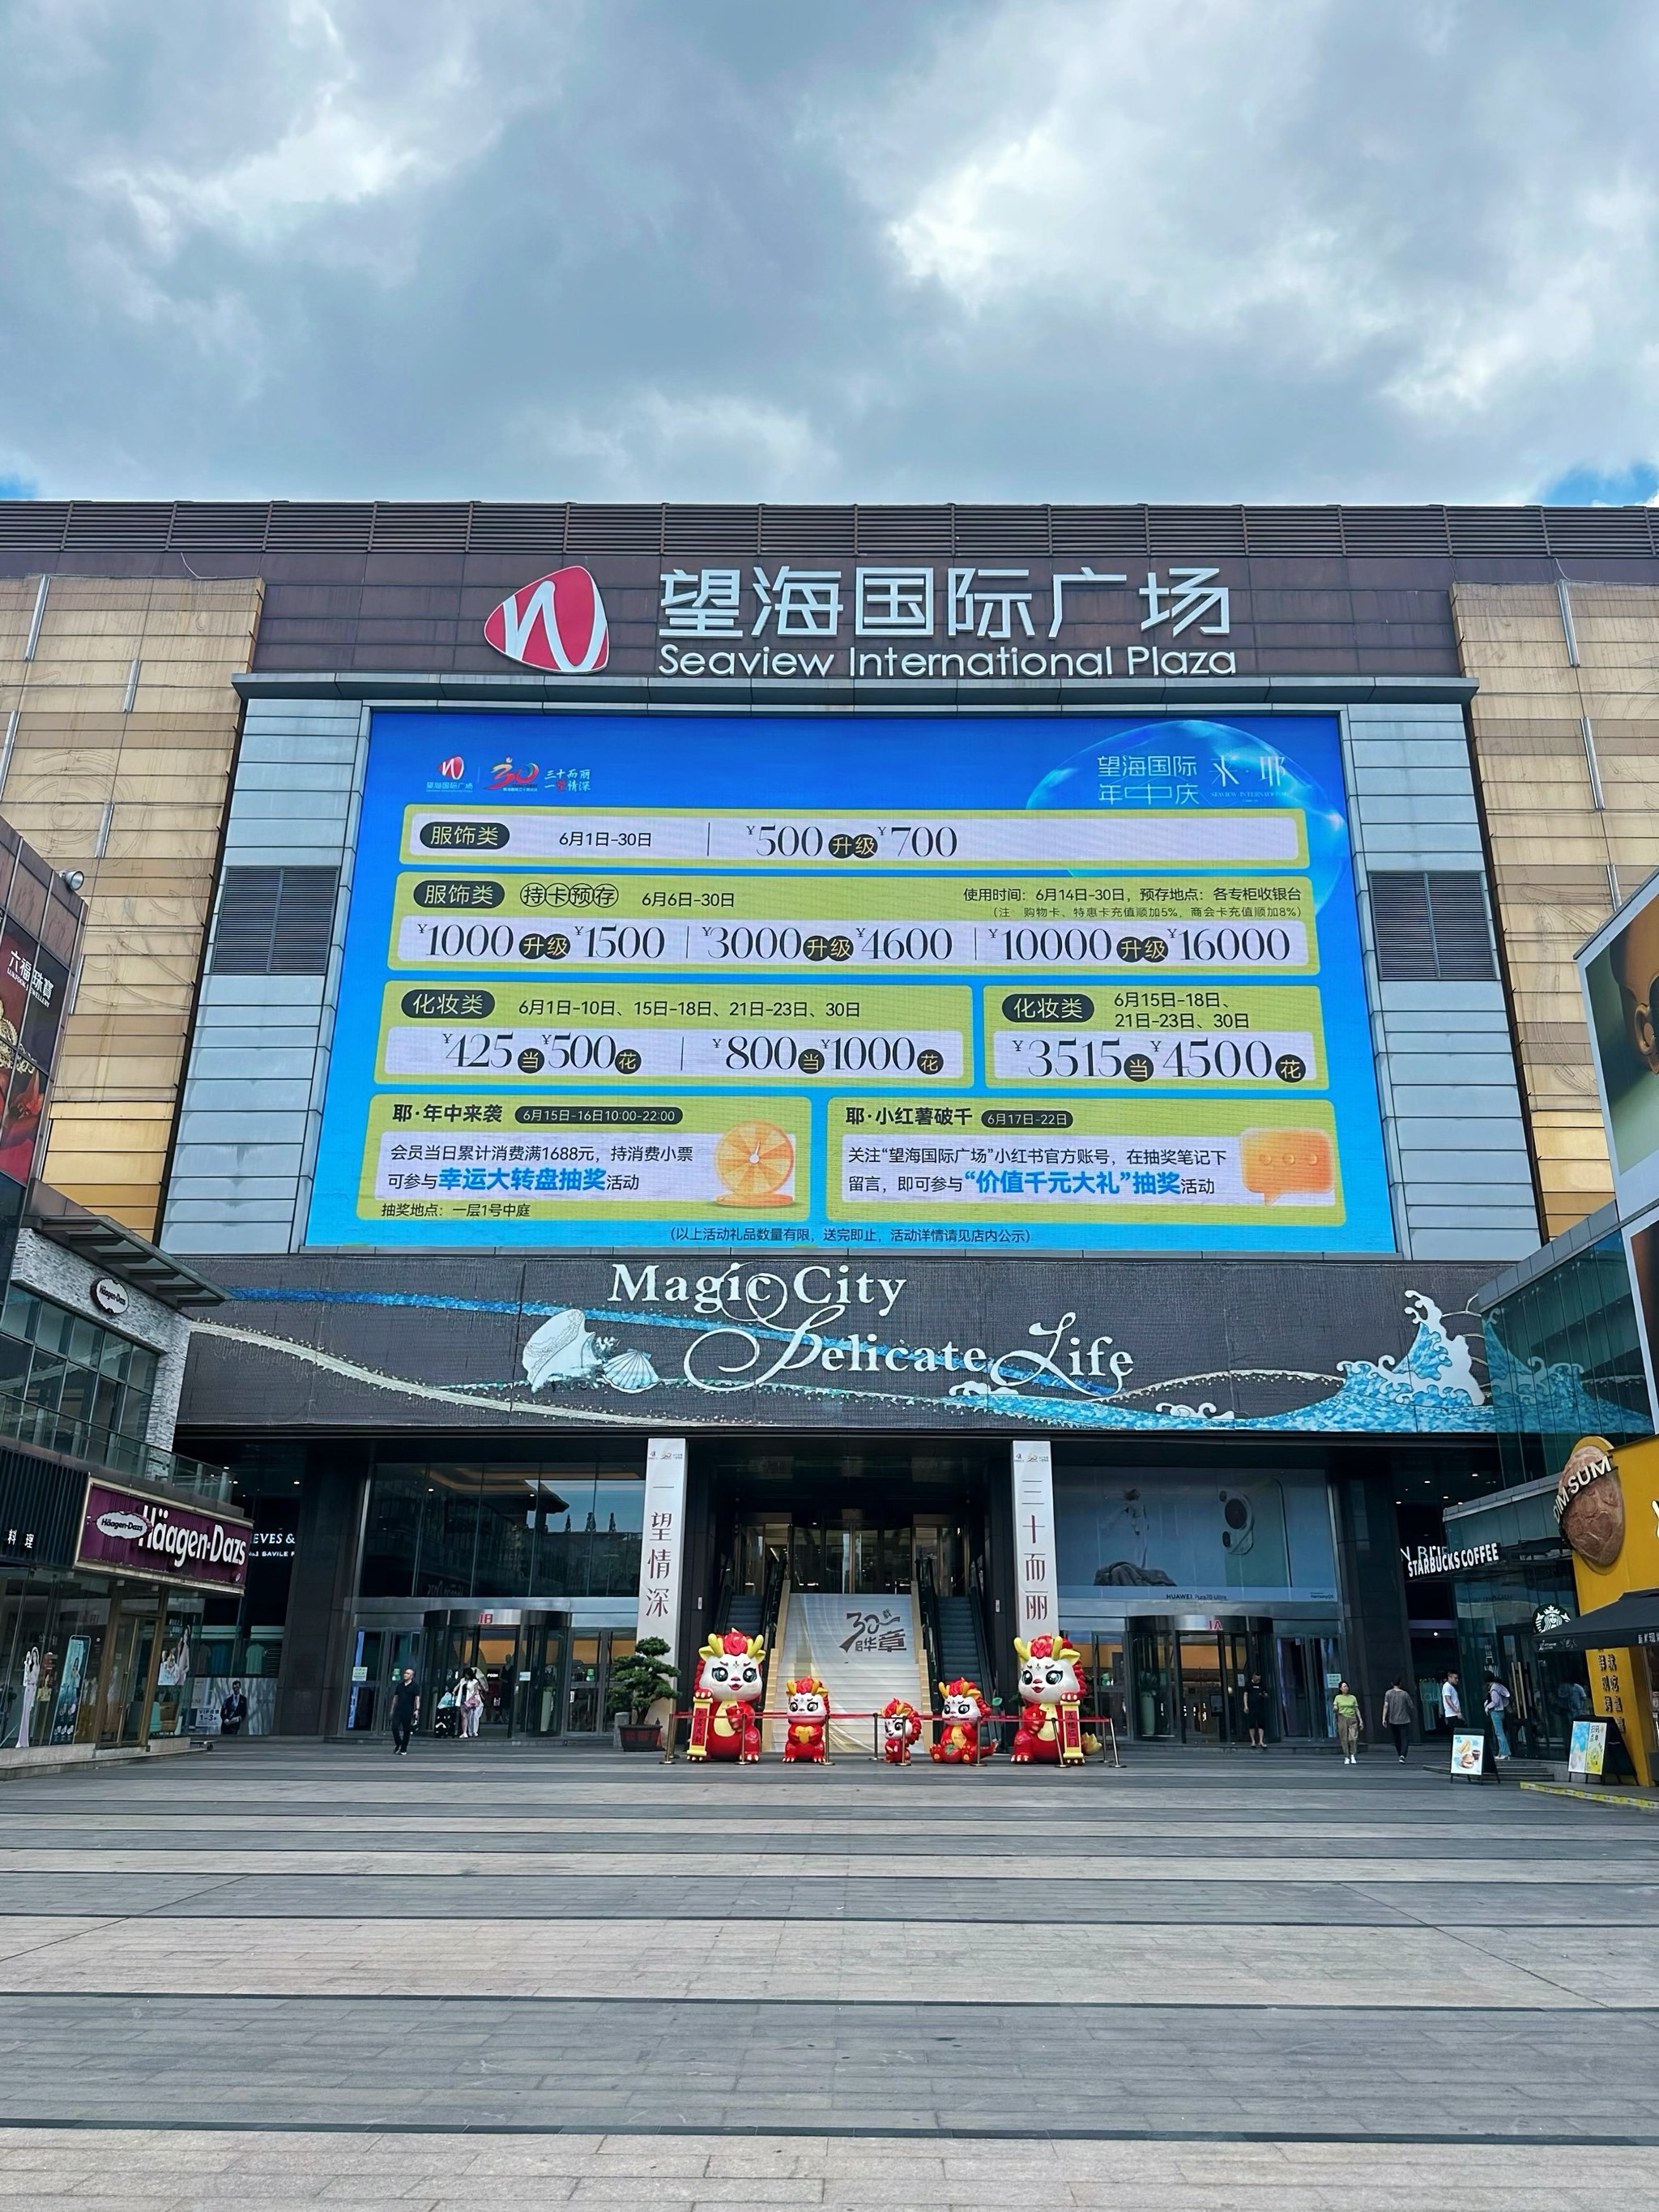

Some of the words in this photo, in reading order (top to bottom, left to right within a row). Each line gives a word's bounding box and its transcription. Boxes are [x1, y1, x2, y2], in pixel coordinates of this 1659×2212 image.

[659, 566, 1230, 638] 望海国际广场
[657, 644, 835, 678] Seaview
[849, 645, 1114, 678] International
[1128, 645, 1237, 678] Plaza
[1098, 755, 1197, 777] 望海国际
[1098, 784, 1200, 805] 年中庆
[430, 825, 499, 845] 服饰类
[559, 831, 652, 848] 6月1日-30日
[424, 884, 493, 905] 服饰类
[521, 883, 618, 907] 持卡预存
[642, 891, 735, 908] 6月6日-30日
[9, 950, 54, 1001] 六福珠寶
[412, 993, 484, 1015] 化妆类
[1013, 997, 1084, 1019] 化妆类
[1115, 1012, 1250, 1030] 21日-23日、30日
[987, 1112, 1068, 1127] 6月17日-22日
[608, 1263, 787, 1321] Magic
[795, 1264, 907, 1316] City
[684, 1305, 987, 1392] Delicate
[990, 1311, 1135, 1401] Life
[1553, 1486, 1570, 1524] DIM
[1567, 1455, 1612, 1495] SUM
[101, 1518, 143, 1531] Häagen-Dazs
[139, 1505, 246, 1567] Häagen-Dazs
[285, 1533, 296, 1544] &
[646, 1484, 674, 1618] 一望情深
[1021, 1479, 1048, 1621] 三十而丽
[1408, 1551, 1461, 1578] STARBUCKS
[1461, 1542, 1499, 1568] COFFEE
